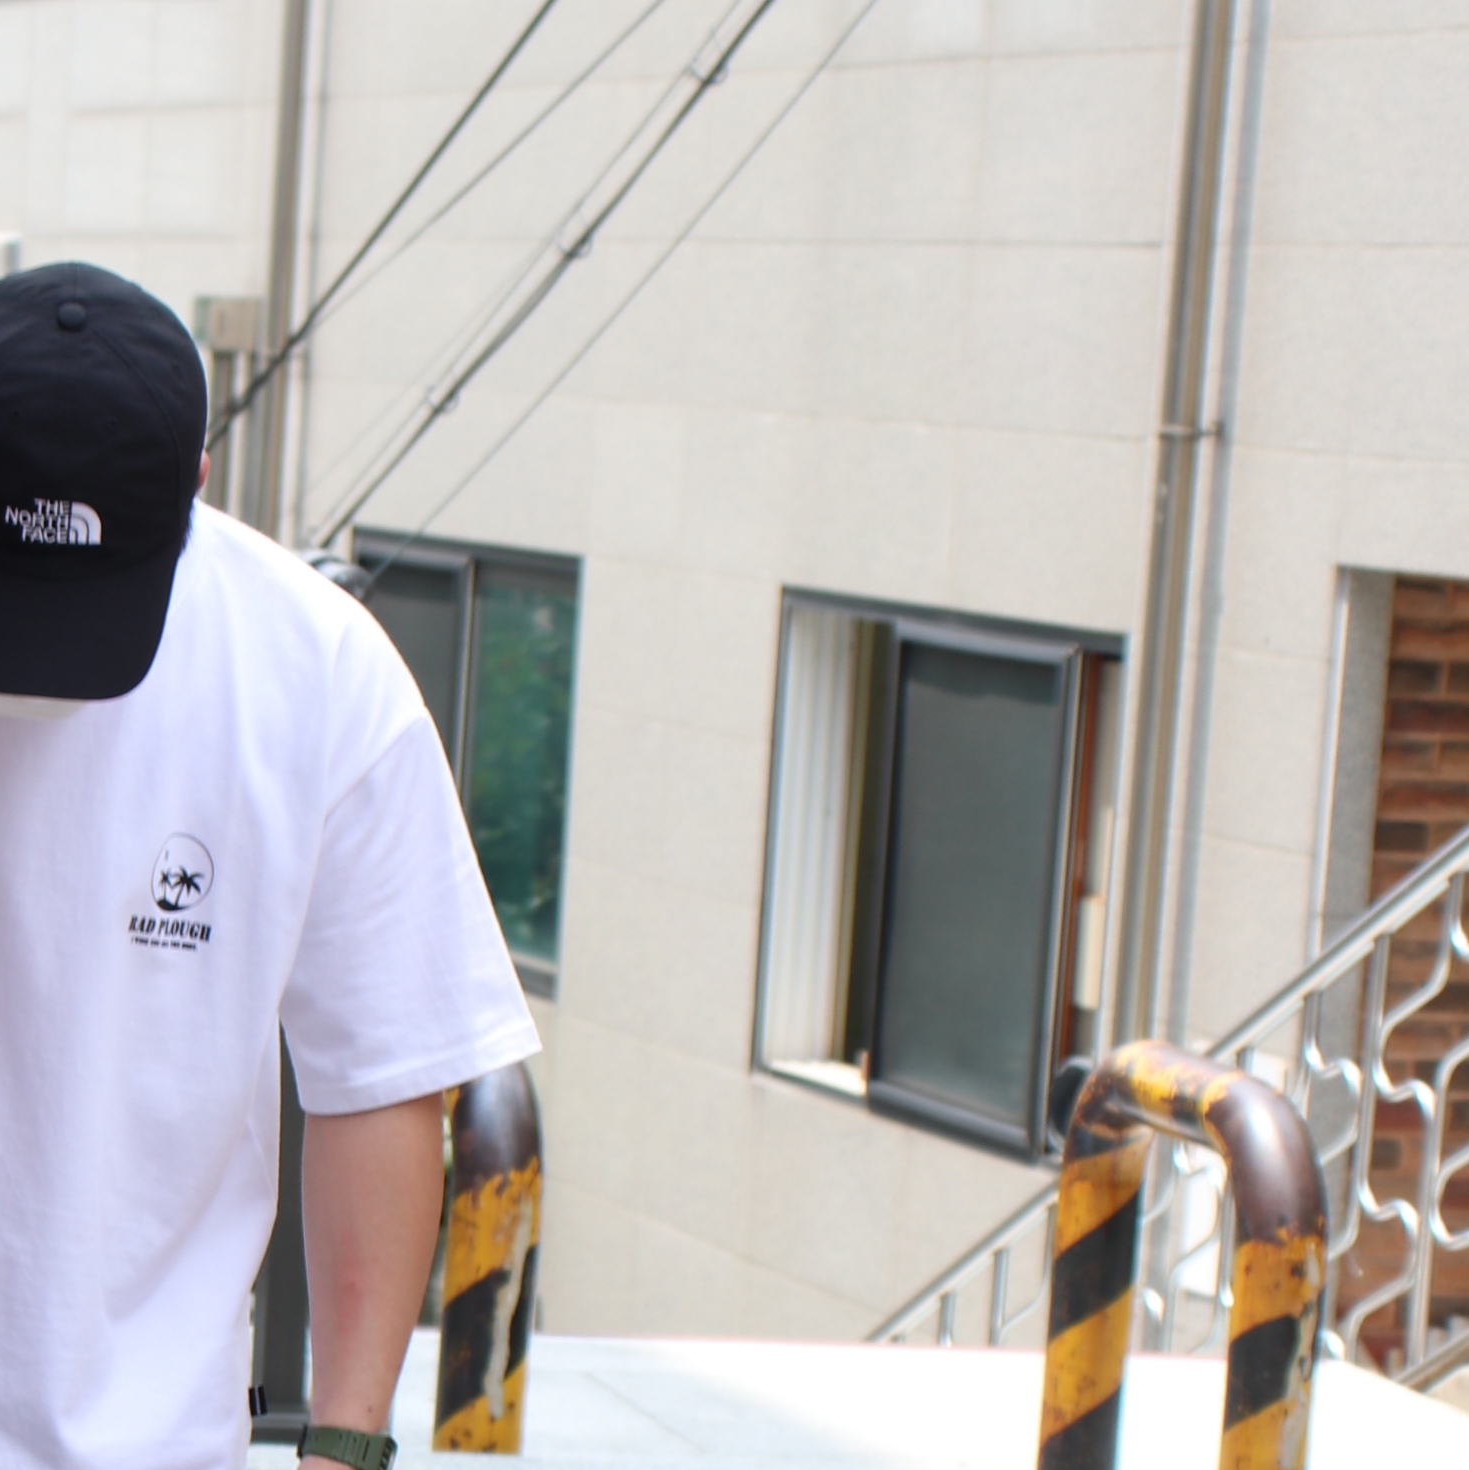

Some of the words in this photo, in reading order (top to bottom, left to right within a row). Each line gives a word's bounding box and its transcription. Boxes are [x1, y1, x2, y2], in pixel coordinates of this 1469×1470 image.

[4, 504, 69, 531] NORTH
[34, 497, 70, 516] THE
[21, 525, 68, 545] FACE
[158, 918, 212, 943] PLOUGH
